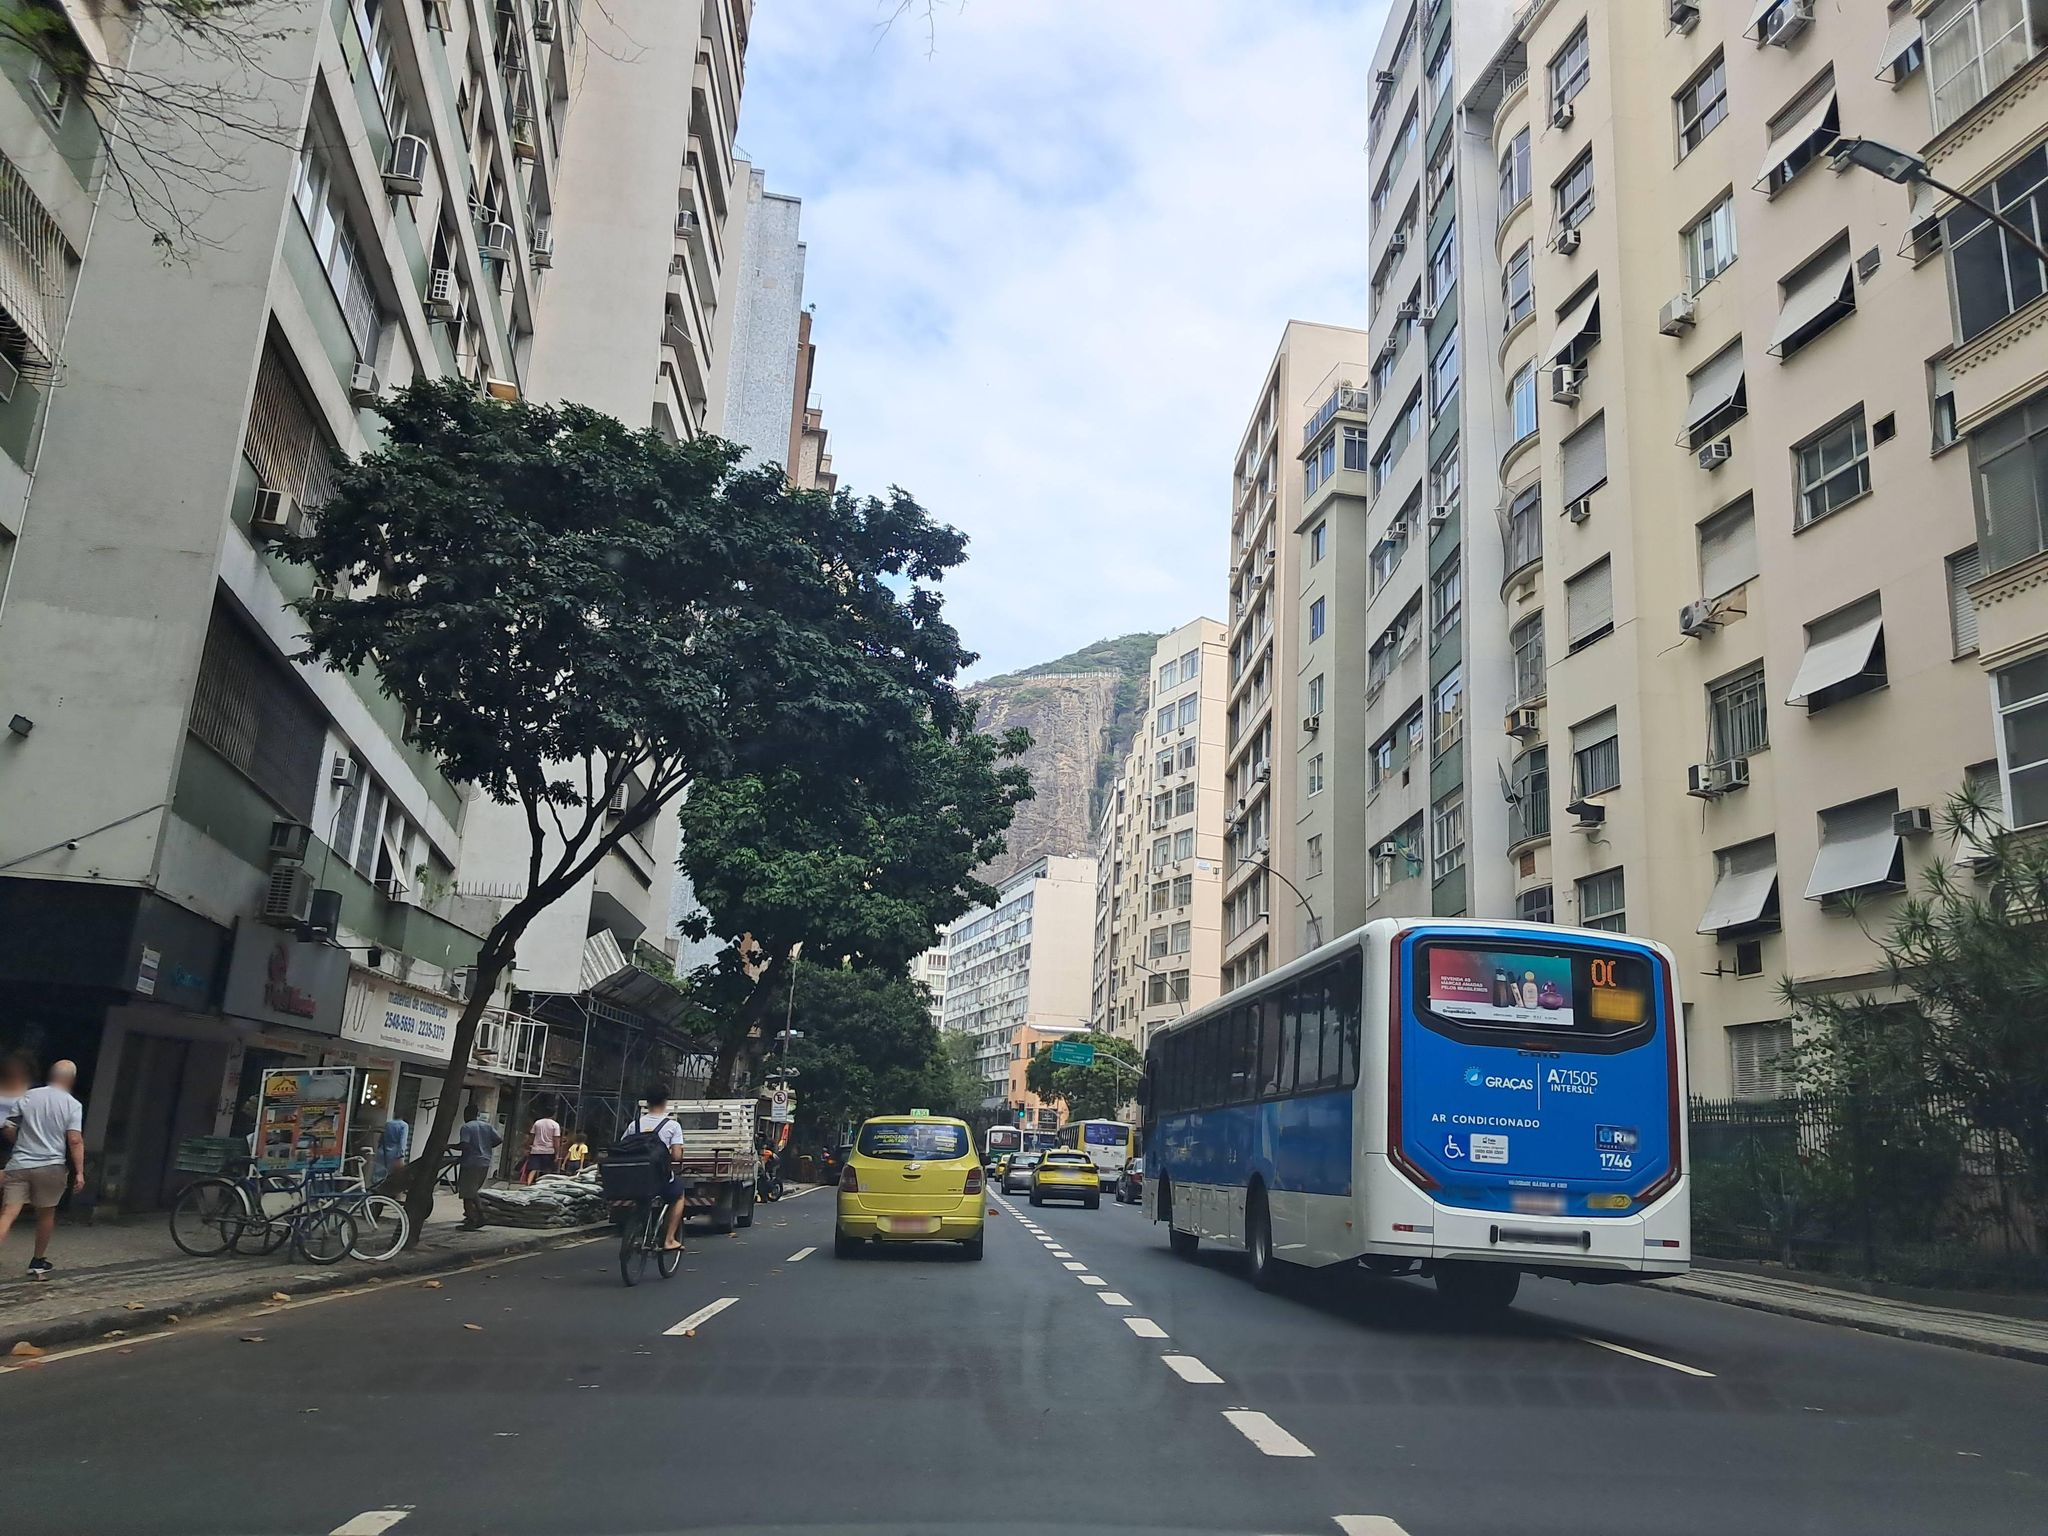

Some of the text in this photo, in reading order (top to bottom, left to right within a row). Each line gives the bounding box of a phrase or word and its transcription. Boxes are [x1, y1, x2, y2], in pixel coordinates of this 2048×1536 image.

[1485, 1076, 1534, 1090] GRAÇAS
[1547, 1069, 1598, 1087] A71505
[1551, 1084, 1594, 1094] INTERSUL
[1431, 1113, 1540, 1128] AR CONDICIONADO
[1600, 1153, 1632, 1168] 1746
